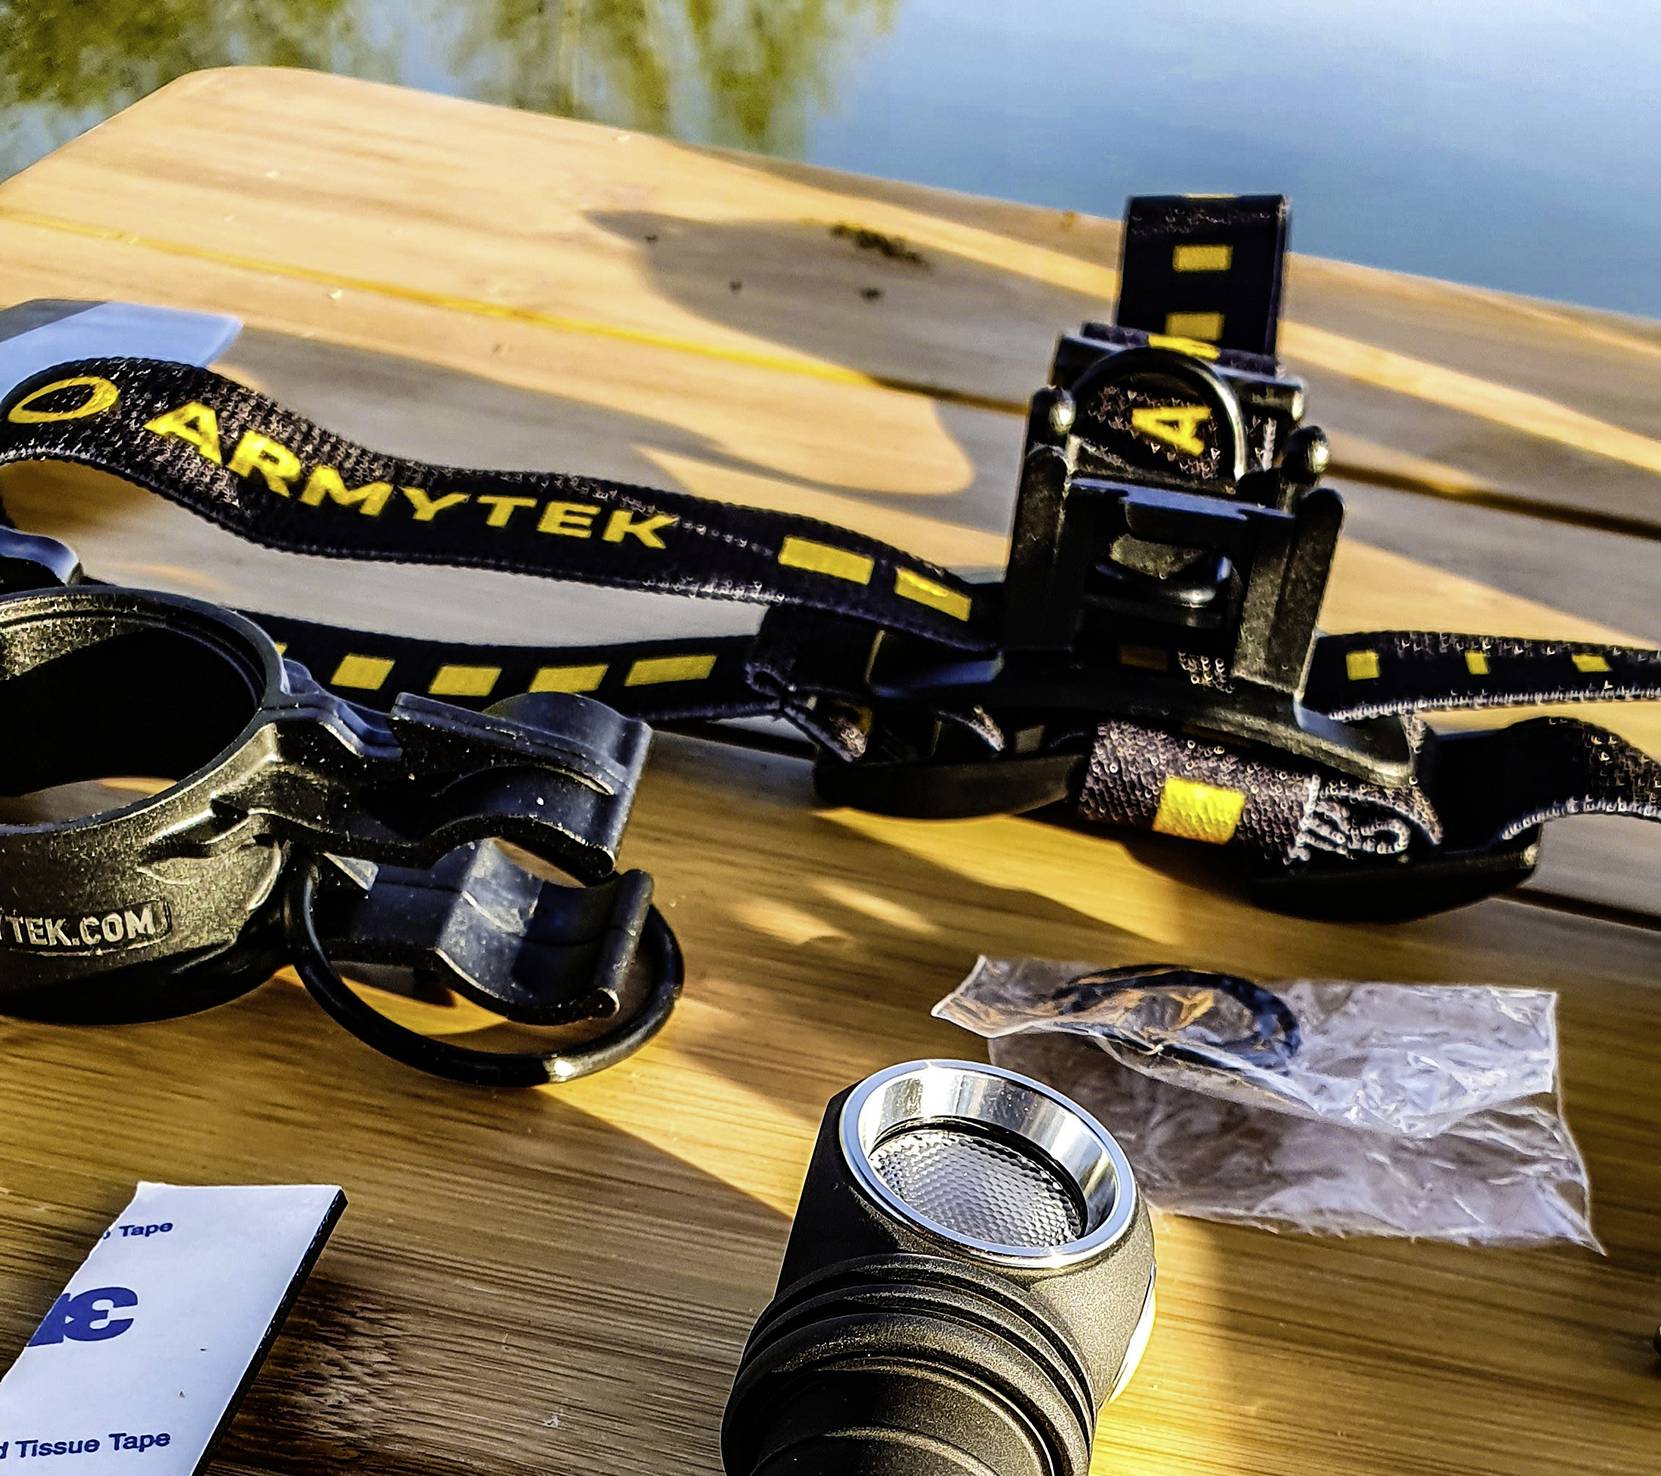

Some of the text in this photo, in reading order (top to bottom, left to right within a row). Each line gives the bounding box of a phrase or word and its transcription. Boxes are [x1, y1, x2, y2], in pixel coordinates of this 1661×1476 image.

[143, 400, 678, 549] ARMYTEK
[0, 907, 156, 946] TEK.COM
[118, 1222, 174, 1238] Tape
[15, 1439, 100, 1458] Tissue
[108, 1432, 171, 1452] Tape
